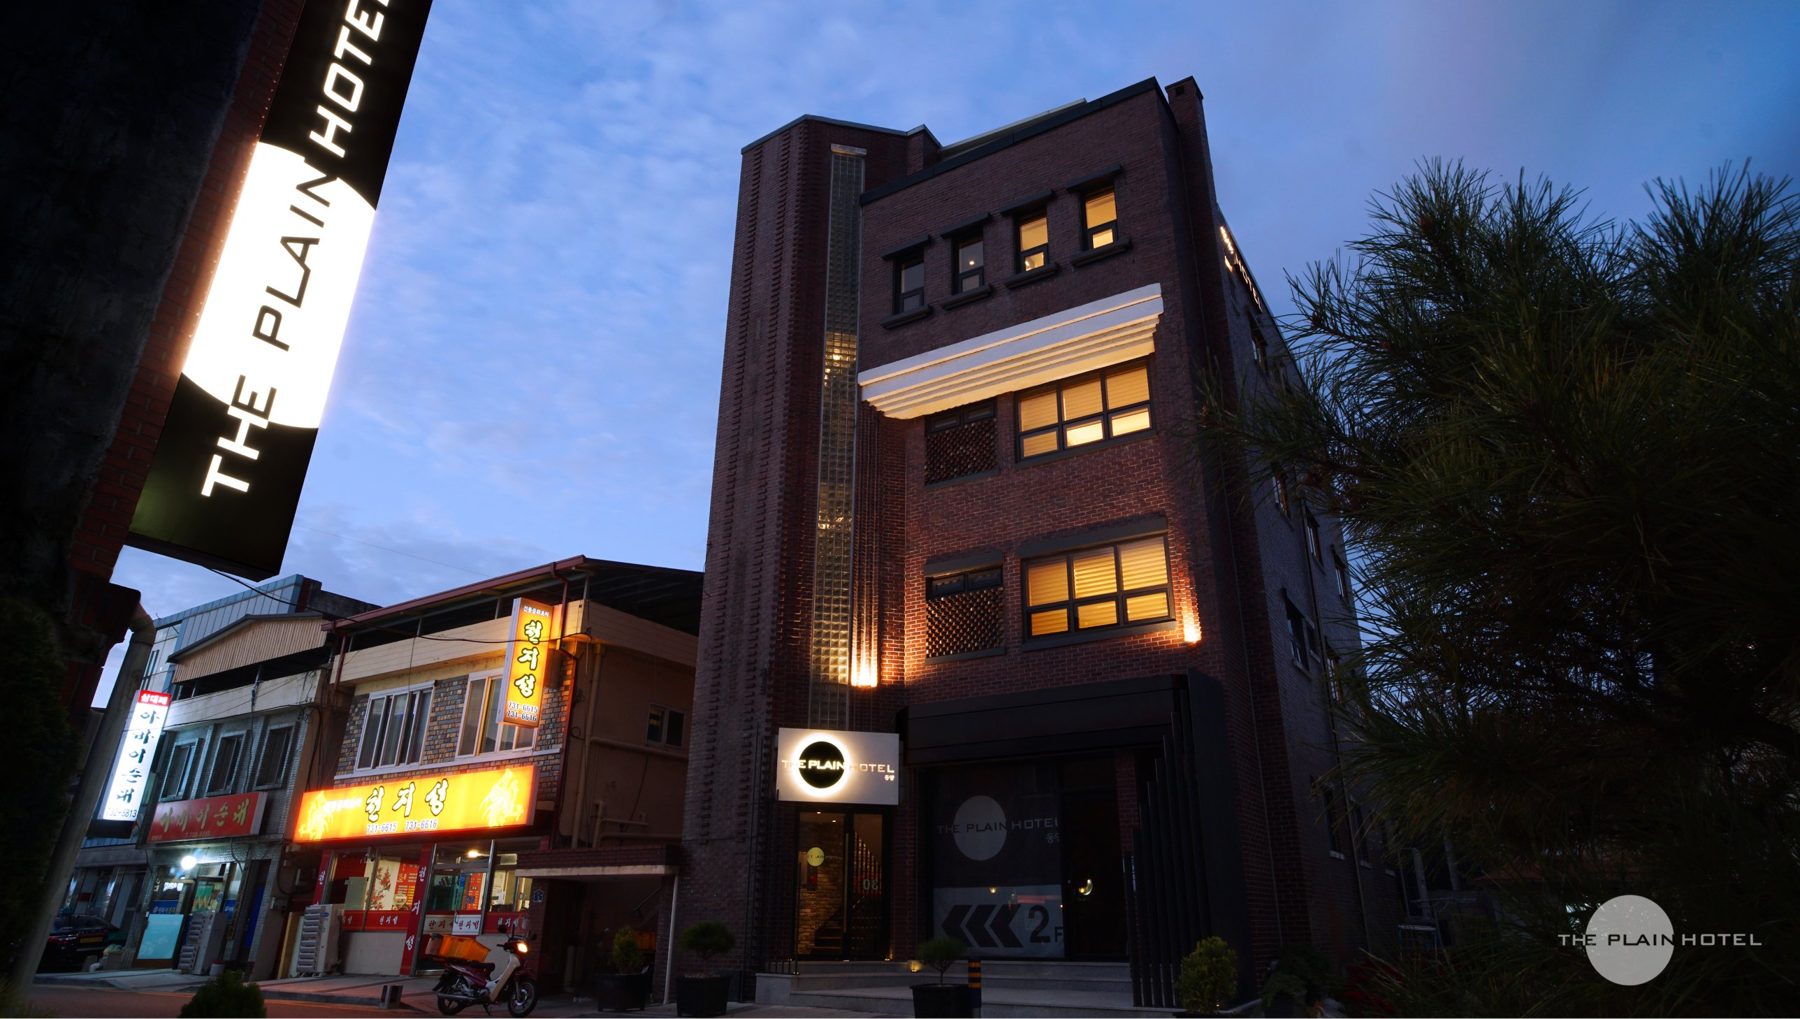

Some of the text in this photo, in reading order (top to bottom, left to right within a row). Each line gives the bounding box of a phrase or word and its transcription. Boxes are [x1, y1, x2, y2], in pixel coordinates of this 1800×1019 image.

[201, 0, 390, 497] THE PLAIN HOTE
[117, 709, 160, 804] 아바이순대
[808, 760, 845, 771] PLAIN
[160, 798, 249, 833] 아바이순대
[937, 824, 960, 834] THE
[966, 822, 1007, 833] PLAIN
